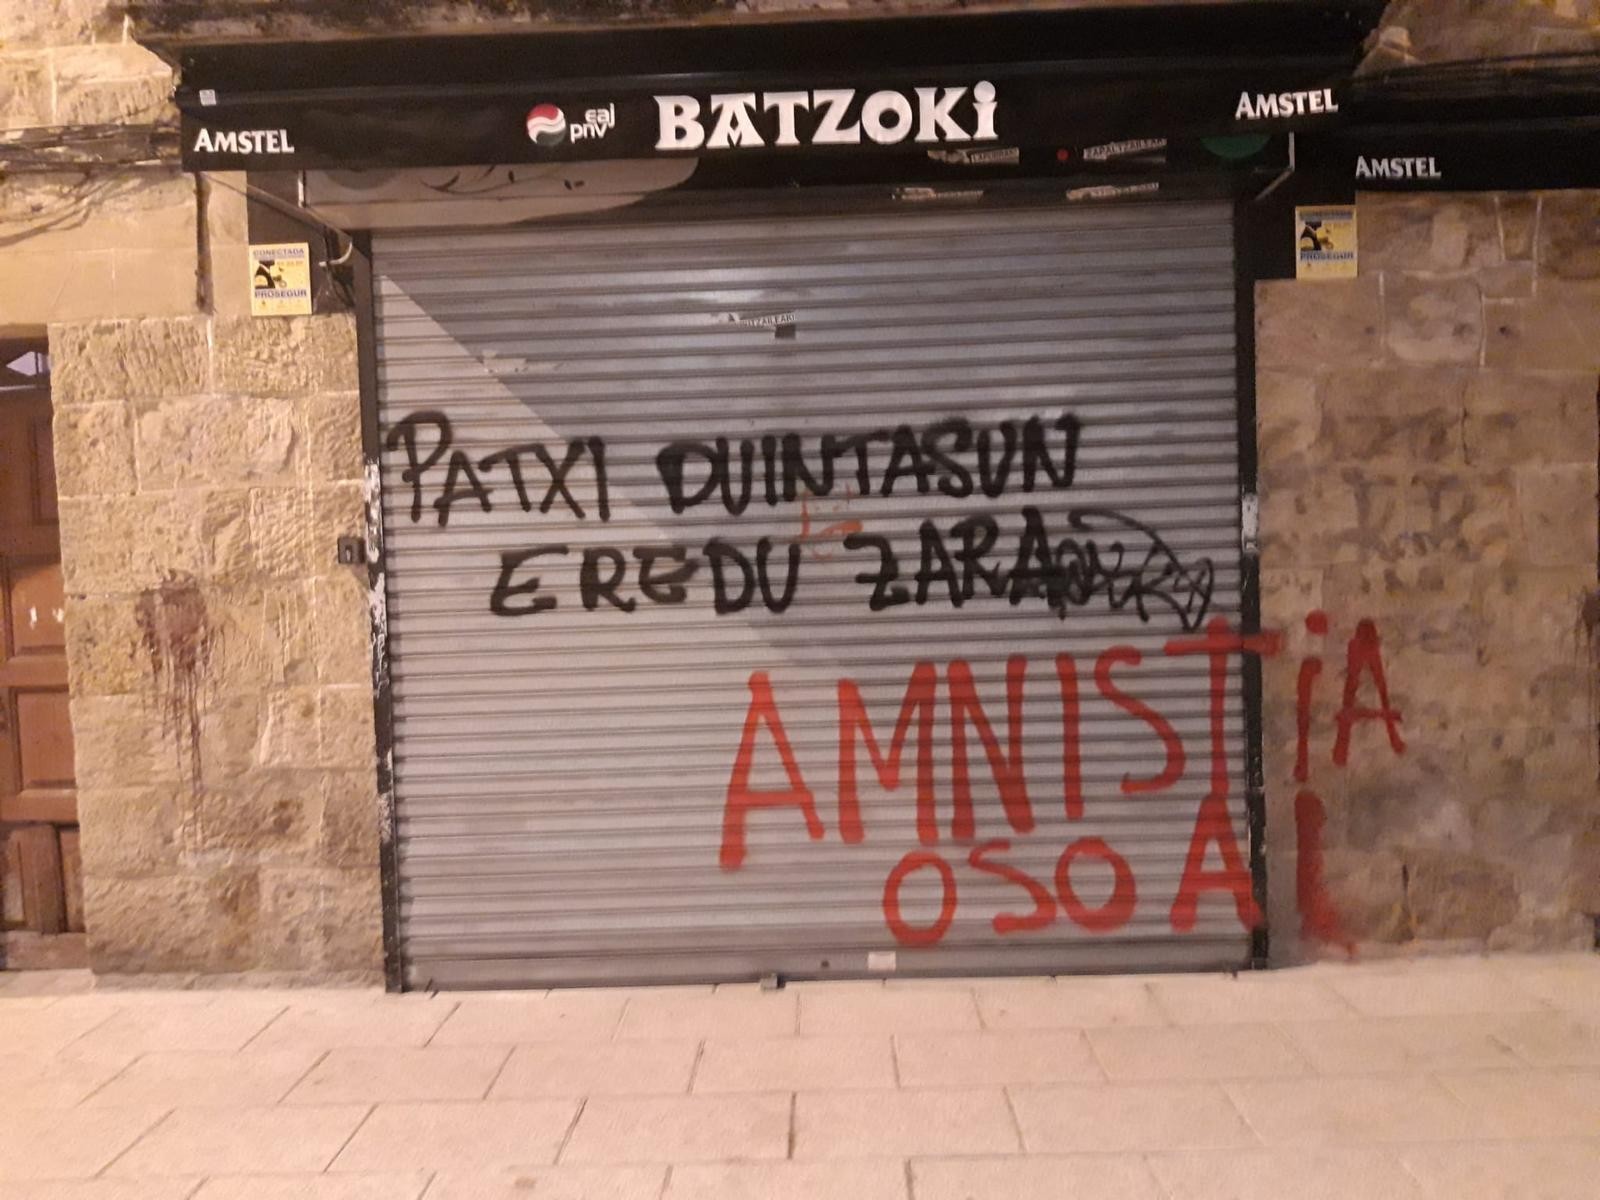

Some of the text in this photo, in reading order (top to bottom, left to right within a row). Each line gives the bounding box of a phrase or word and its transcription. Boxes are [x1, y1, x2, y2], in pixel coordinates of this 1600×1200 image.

[1235, 88, 1339, 120] AMSTEL
[194, 128, 295, 154] AMSTEL
[570, 123, 608, 144] pnv
[1355, 155, 1442, 179] AMSTEL
[255, 289, 307, 299] PROSEGUR
[387, 410, 611, 527] PATXI
[490, 536, 803, 616] EREDU
